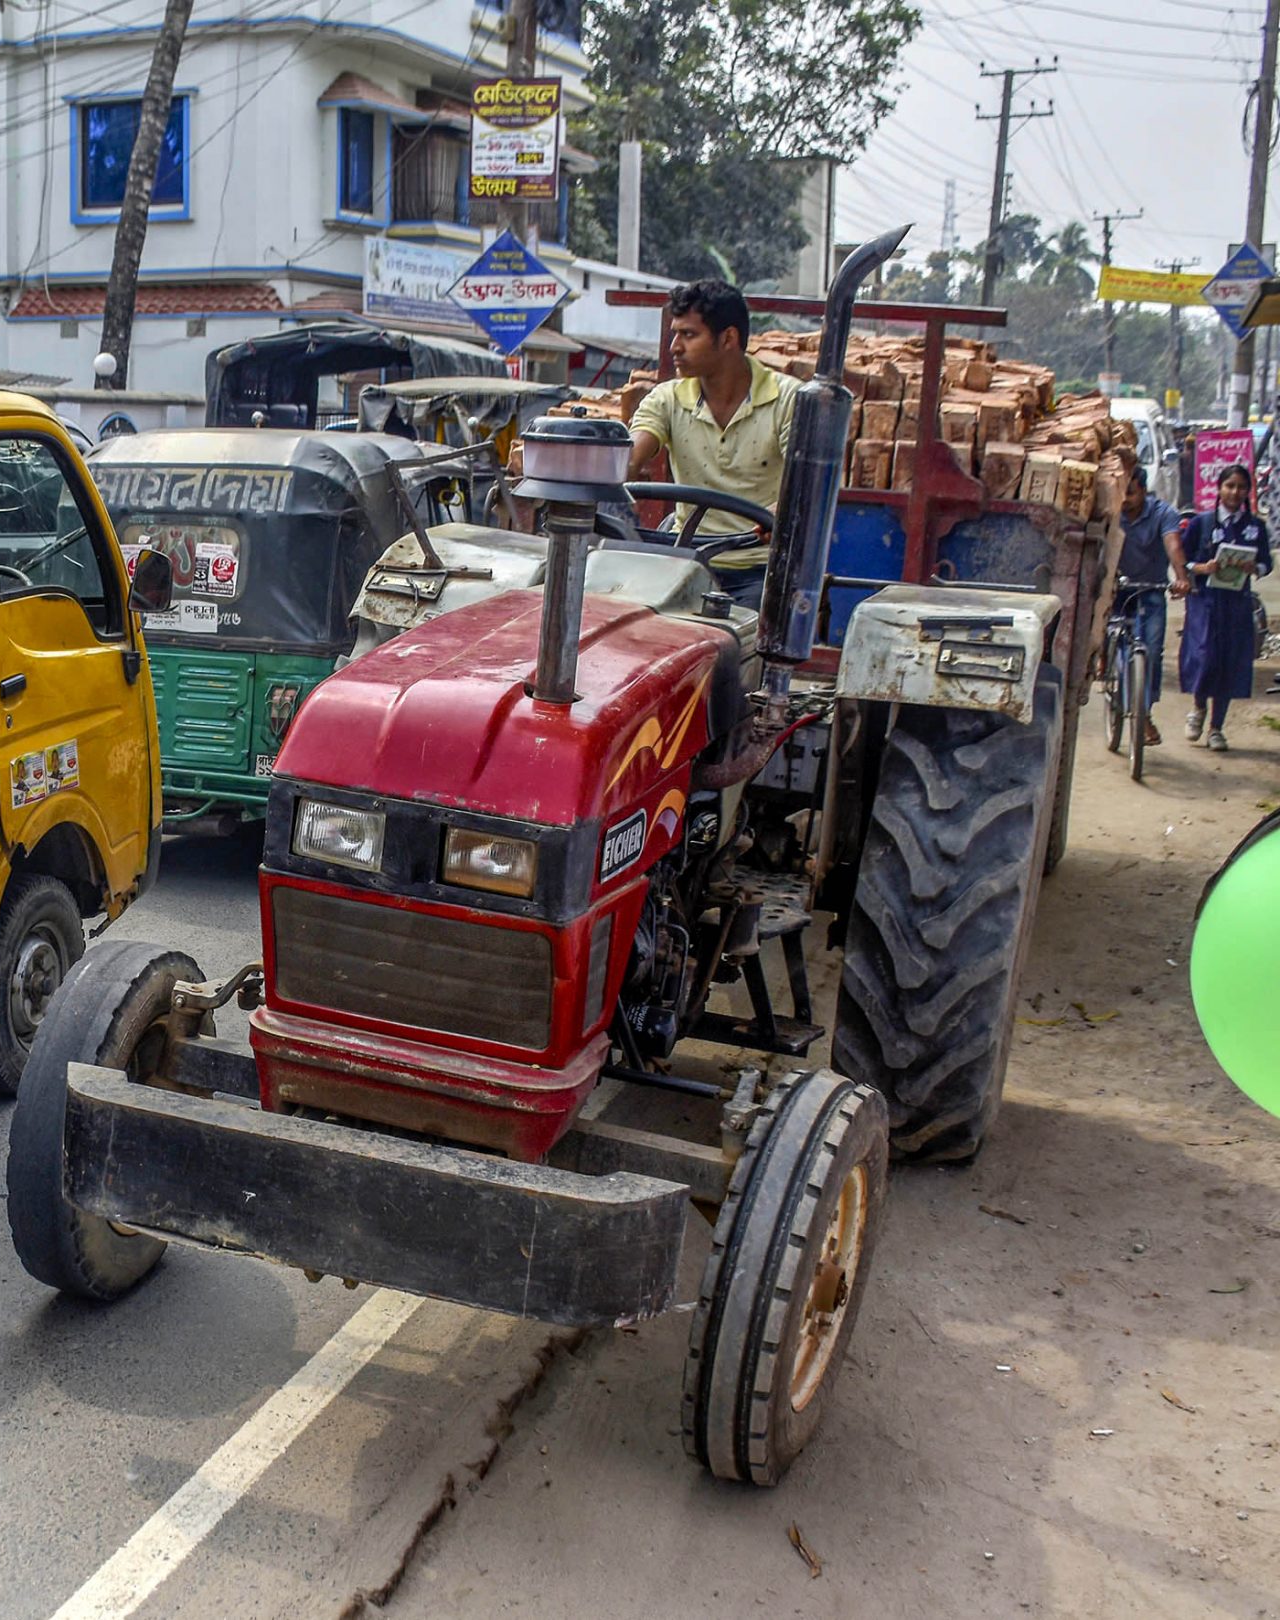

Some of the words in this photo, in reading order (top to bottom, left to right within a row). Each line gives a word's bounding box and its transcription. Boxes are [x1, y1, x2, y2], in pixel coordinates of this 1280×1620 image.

[474, 79, 558, 104] মেডিকেলে
[471, 176, 518, 196] উন্মেষ
[601, 821, 642, 873] EICHER
